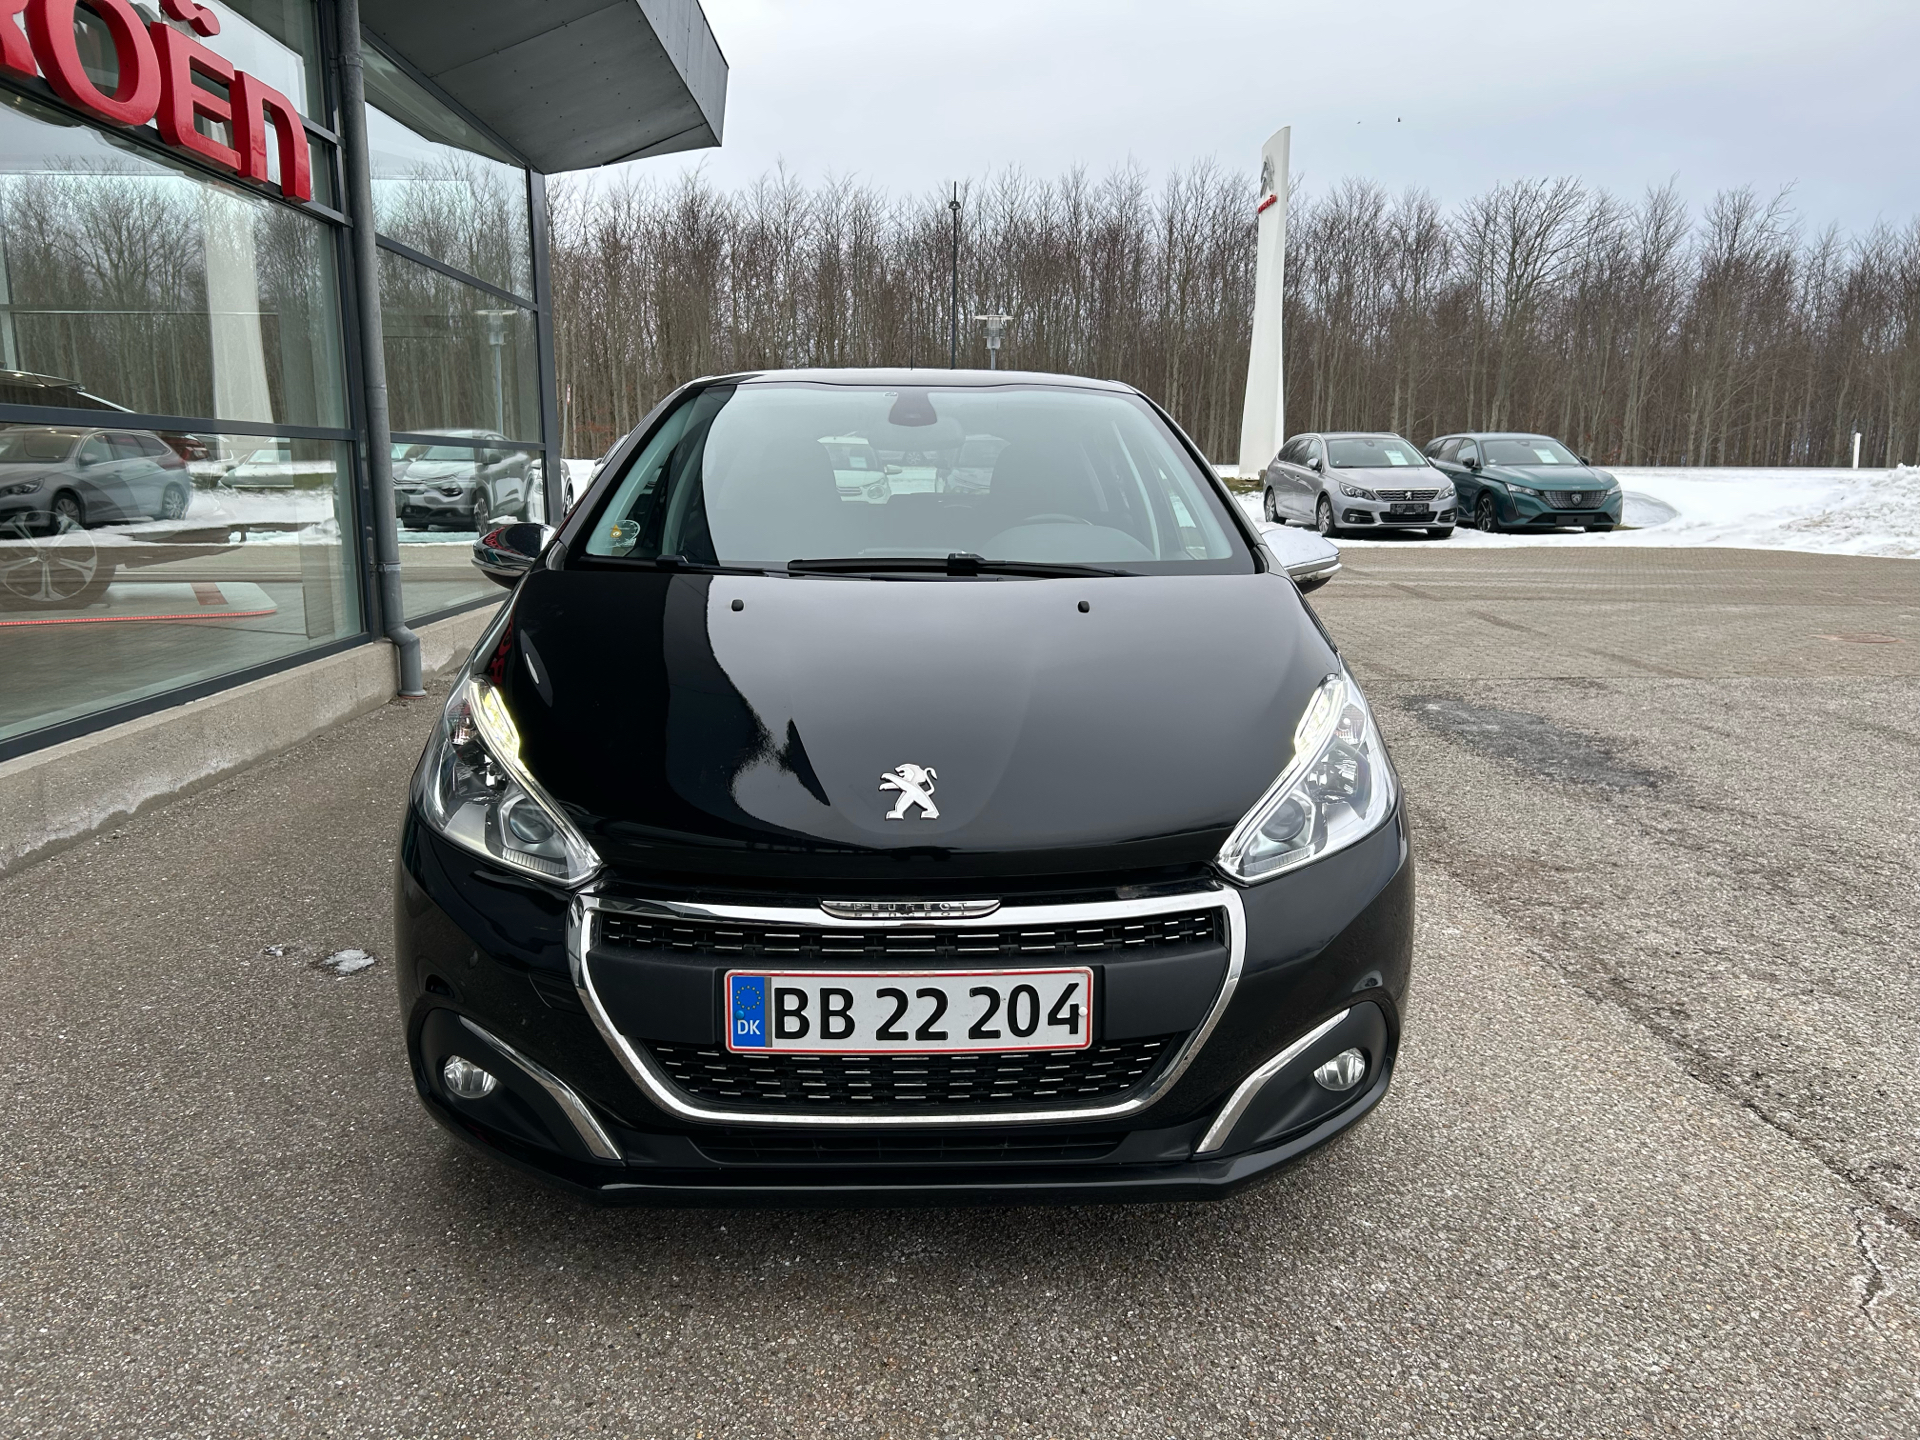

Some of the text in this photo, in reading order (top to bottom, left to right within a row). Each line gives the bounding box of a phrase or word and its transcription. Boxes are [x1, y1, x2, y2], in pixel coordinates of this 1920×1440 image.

[736, 1019, 761, 1035] DK
[774, 982, 1081, 1041] BB 22 204
